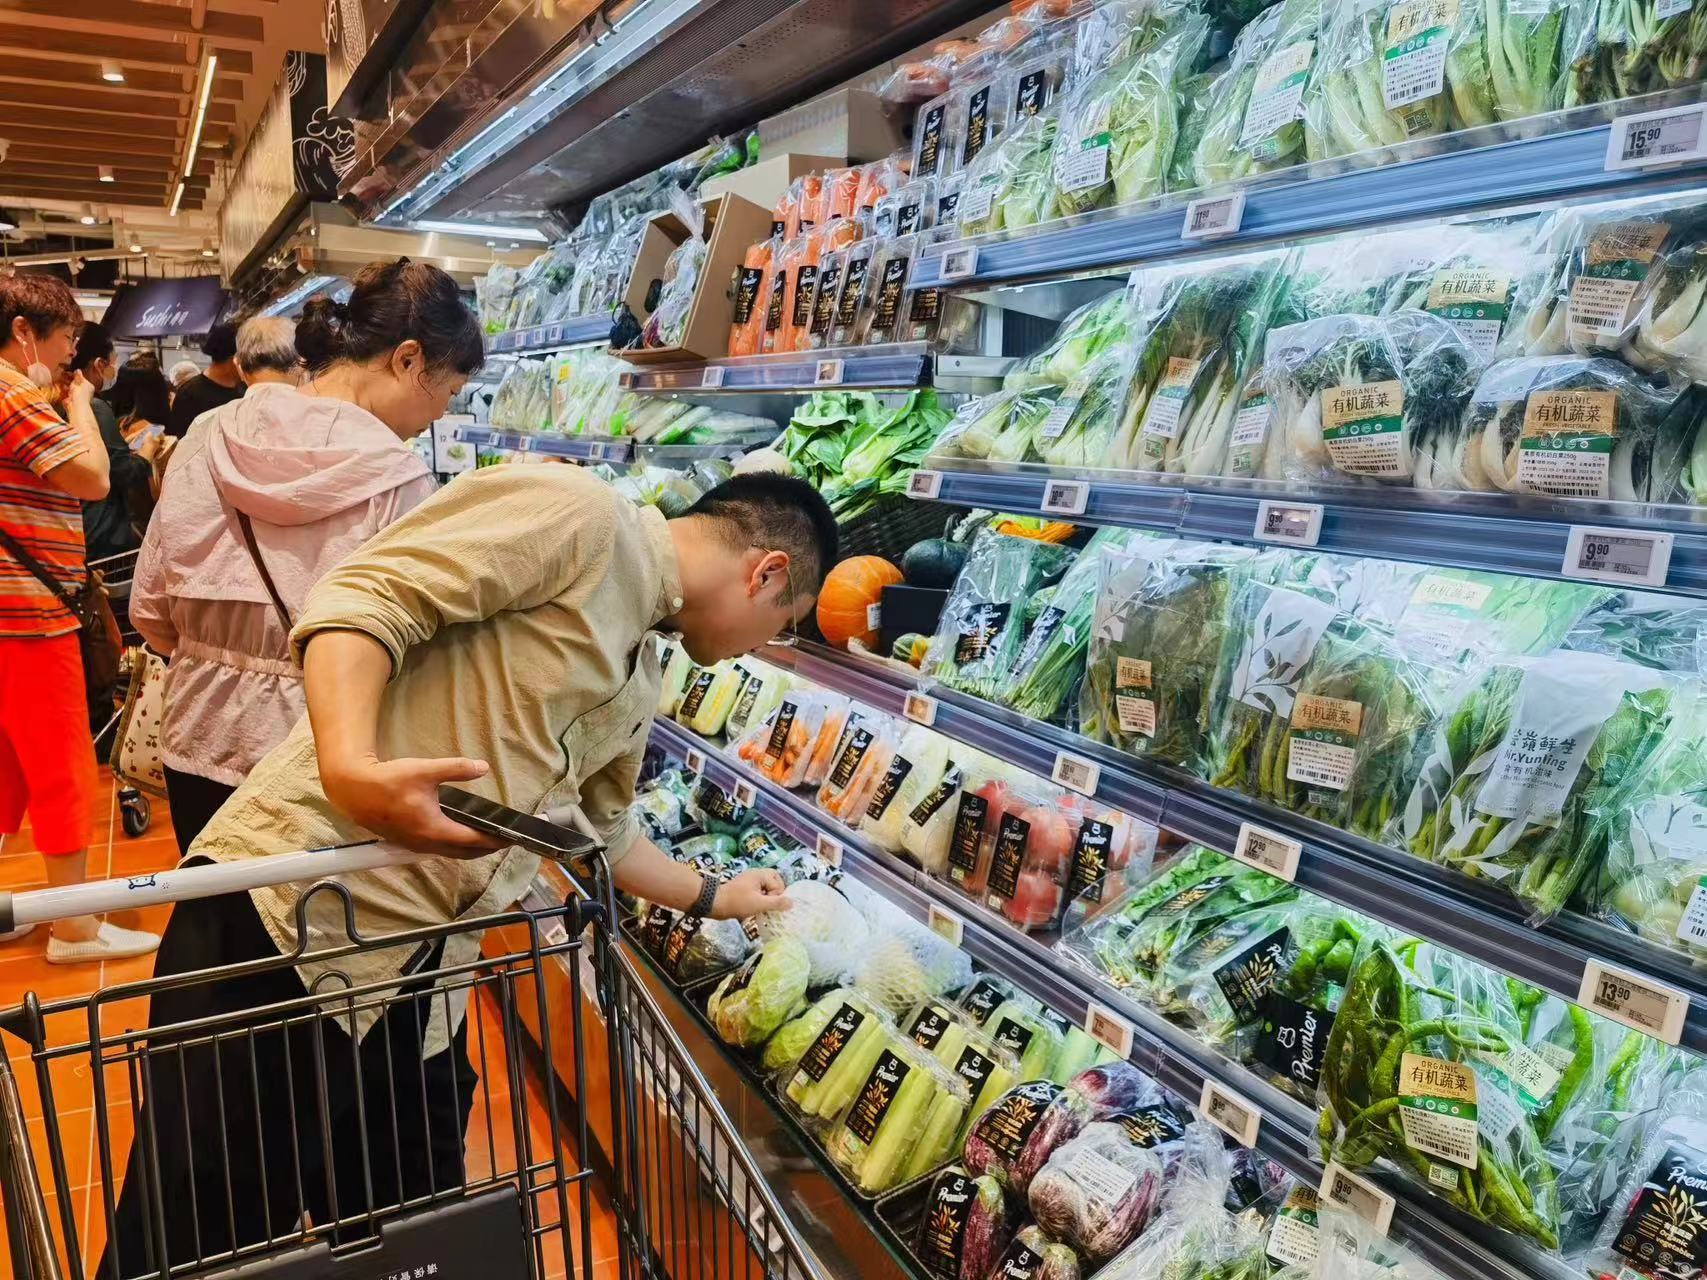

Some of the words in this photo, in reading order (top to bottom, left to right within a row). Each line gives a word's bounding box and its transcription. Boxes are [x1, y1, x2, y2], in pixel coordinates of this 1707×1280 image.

[1453, 272, 1490, 280] ORGANIC
[1440, 279, 1496, 294] 有机蔬菜
[1340, 386, 1379, 397] ORGANIC
[1547, 396, 1591, 404] ORGANIC
[1332, 392, 1390, 413] 有机蔬菜
[1535, 404, 1601, 423] 有机蔬菜
[1302, 704, 1351, 724] 有机蔬菜
[1290, 1010, 1318, 1082] Premier
[1421, 1059, 1459, 1074] ORGANIC
[1411, 1066, 1468, 1092] 有机蔬菜
